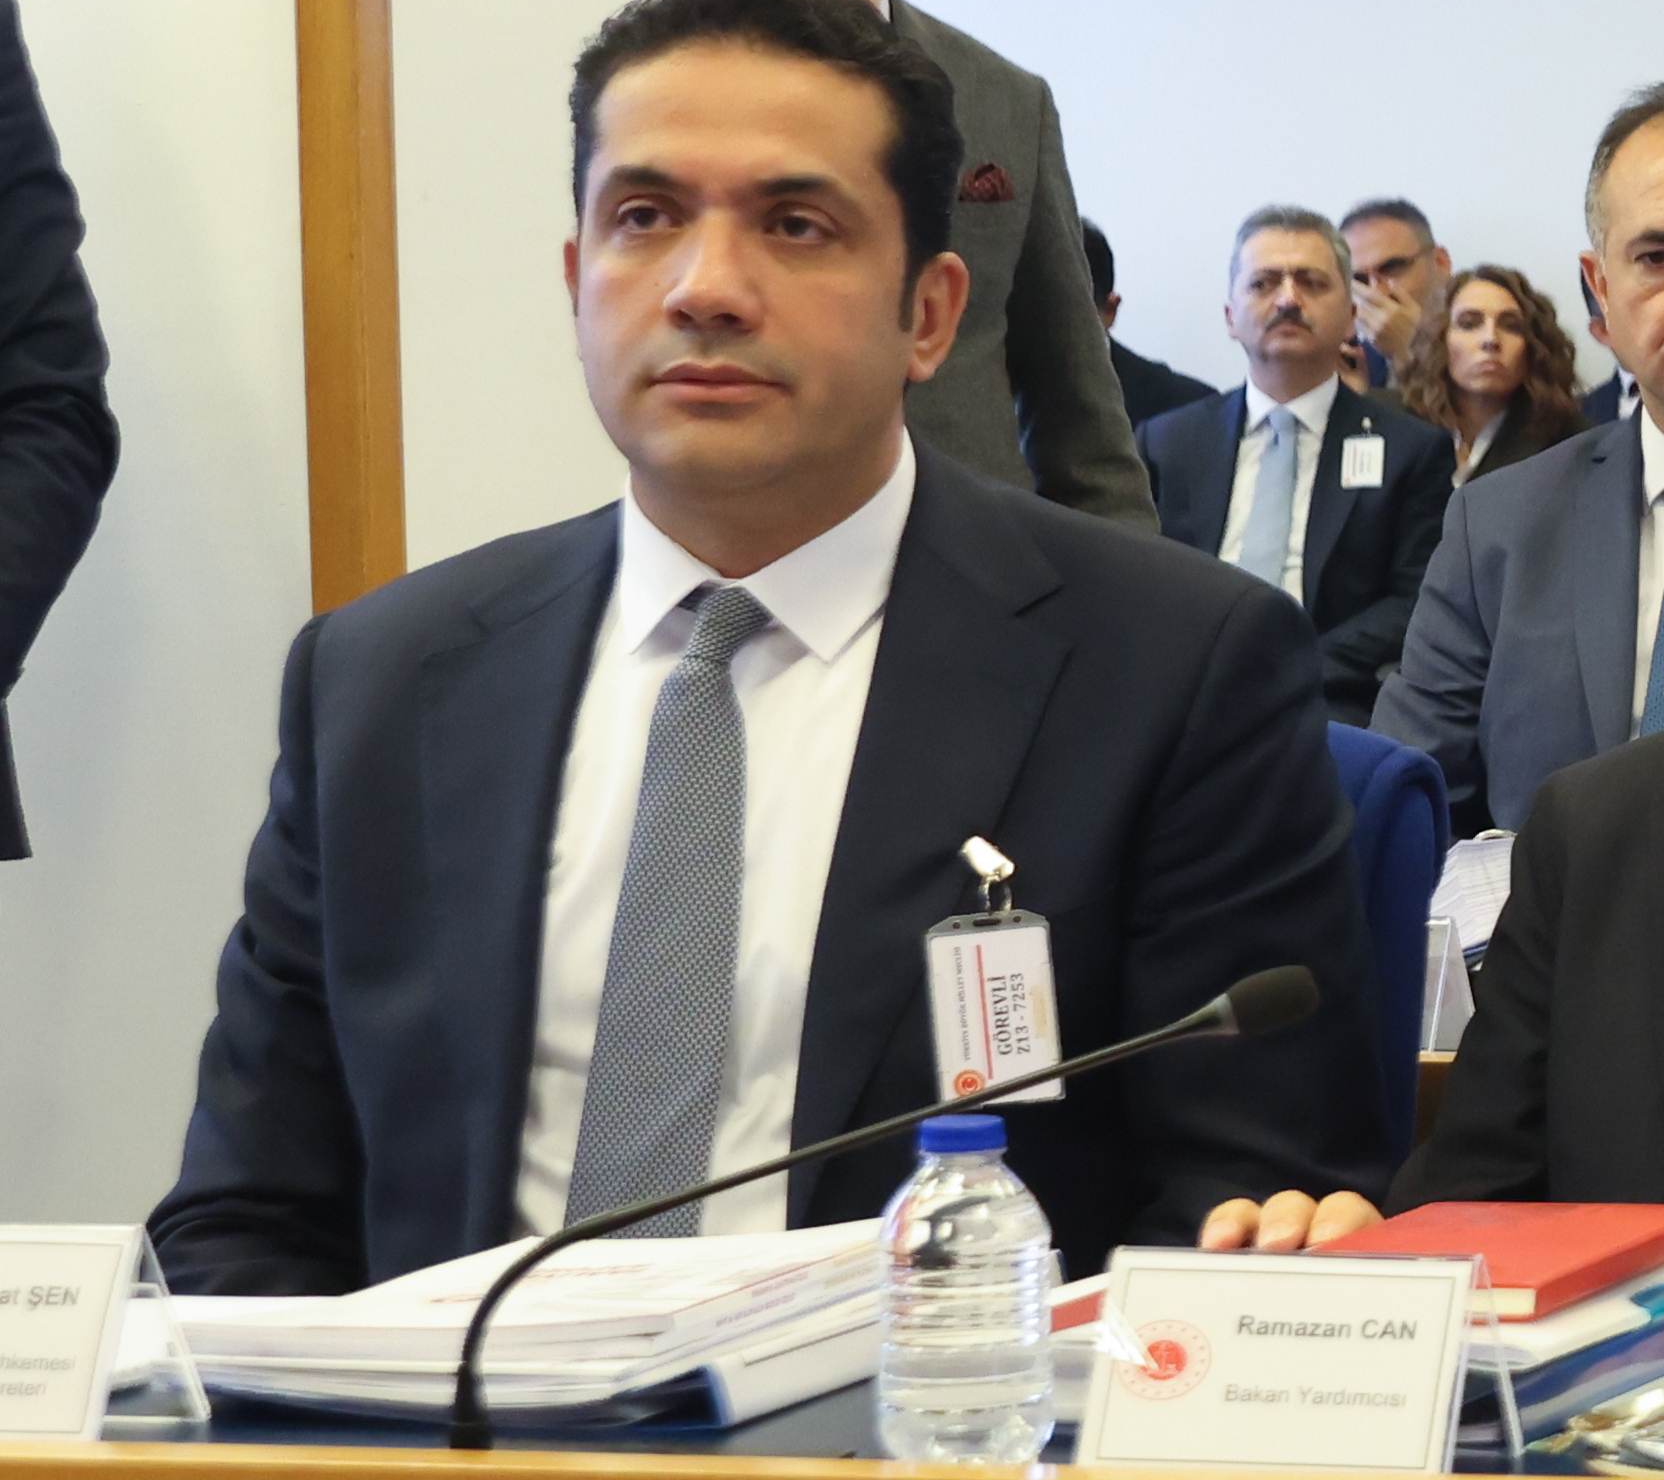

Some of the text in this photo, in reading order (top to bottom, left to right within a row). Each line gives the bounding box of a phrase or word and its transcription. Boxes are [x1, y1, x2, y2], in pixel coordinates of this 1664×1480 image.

[1009, 972, 1025, 1012] 7253
[987, 975, 1013, 1056] GÖREVLİ
[1015, 1025, 1031, 1055] Z13
[27, 1285, 81, 1311] ŞEN
[1237, 1315, 1418, 1341] Ramazan CAN
[1224, 1384, 1407, 1408] Bakan Yardımcısı
